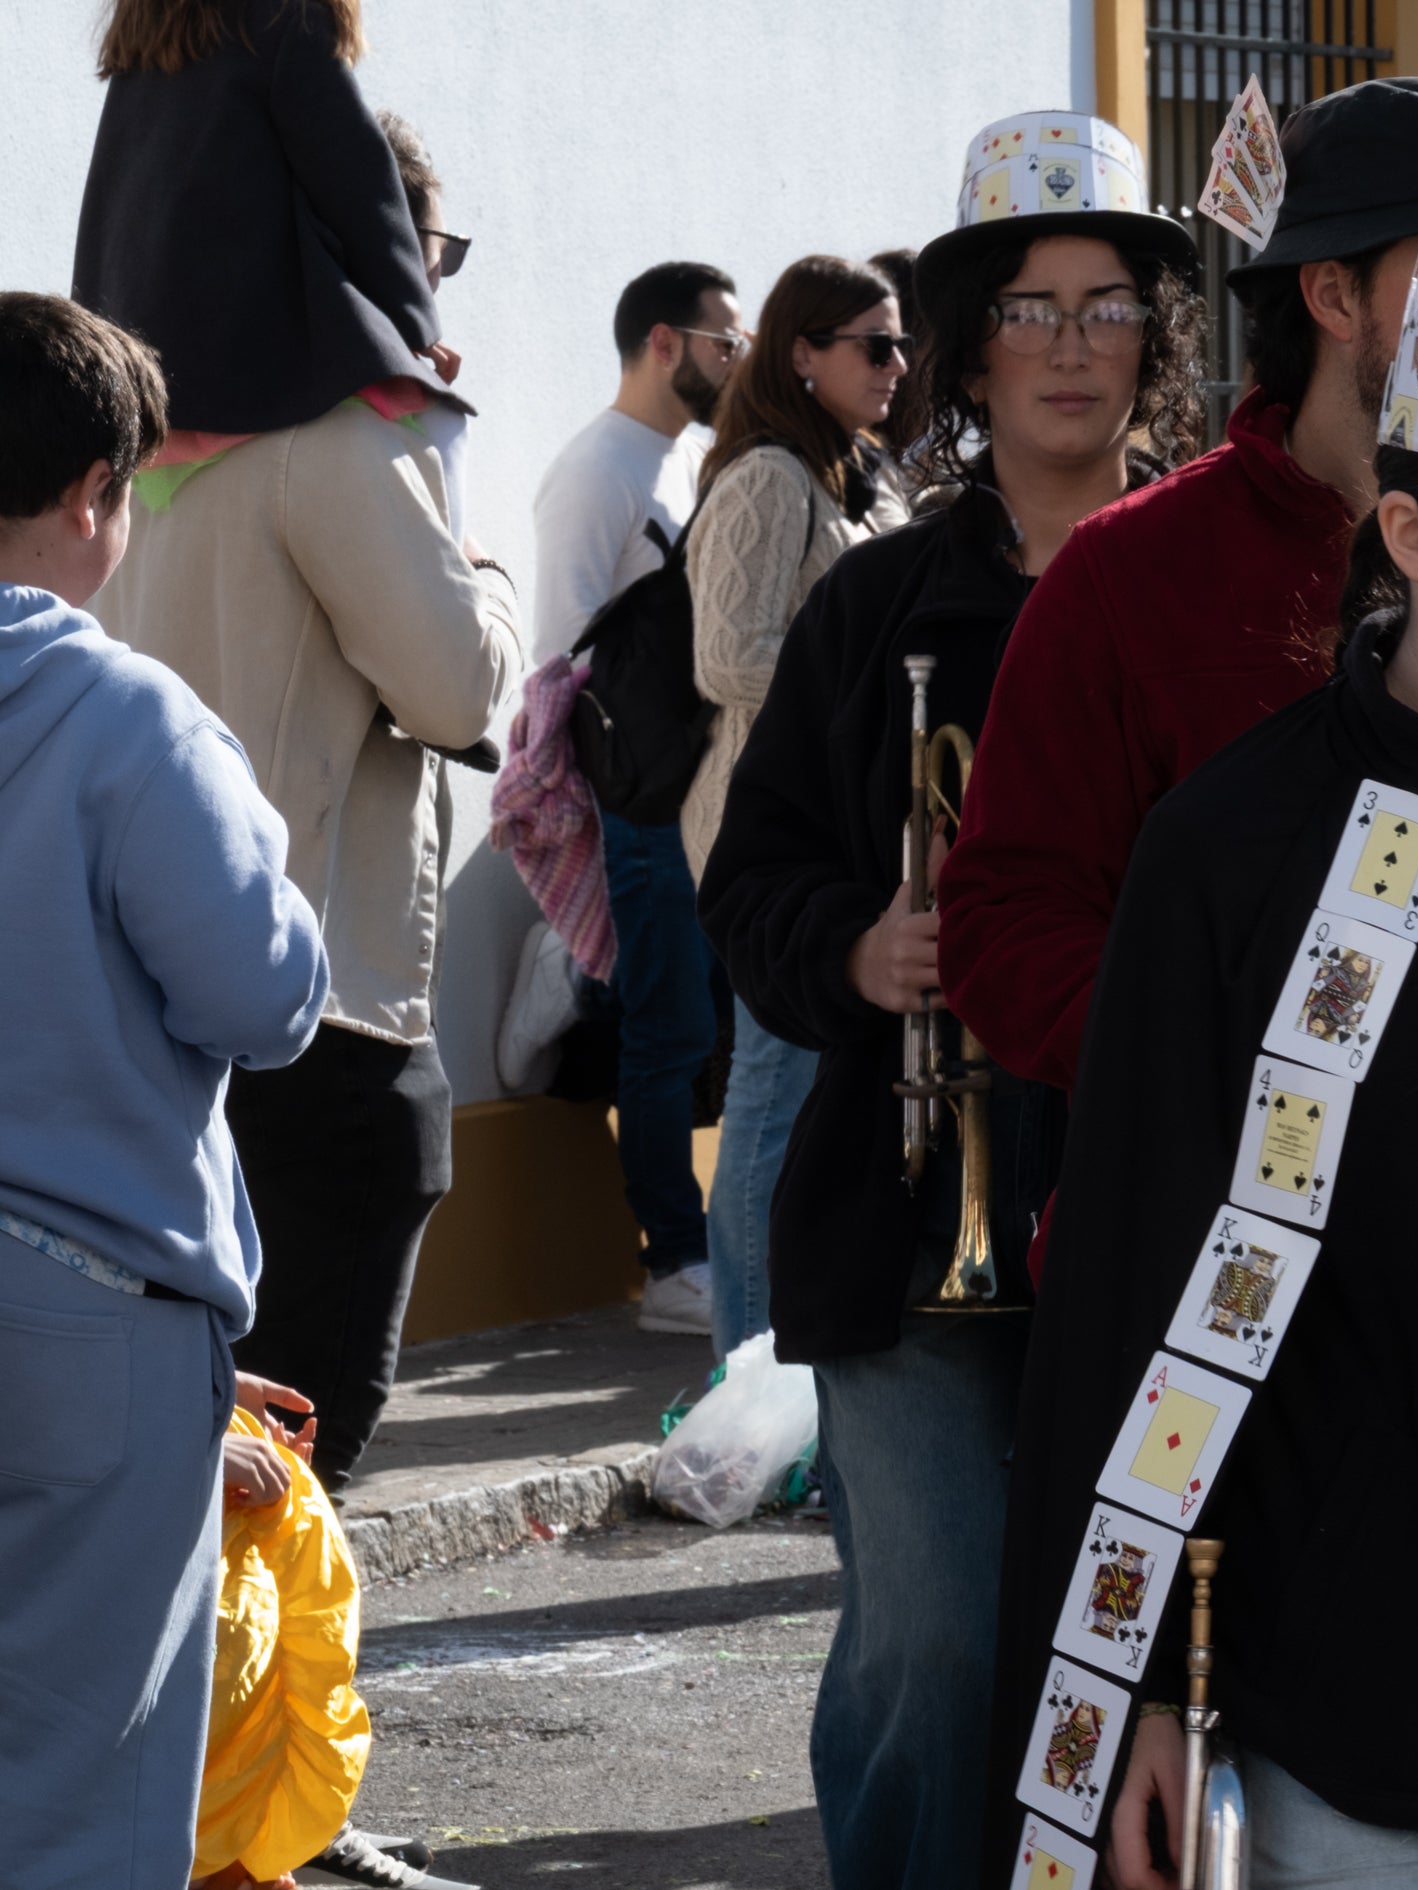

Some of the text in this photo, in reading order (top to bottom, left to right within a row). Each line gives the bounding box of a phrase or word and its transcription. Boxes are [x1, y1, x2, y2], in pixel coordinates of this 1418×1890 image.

[1204, 202, 1212, 213] J
[1363, 791, 1378, 810] 3
[1404, 910, 1418, 931] 3
[1315, 922, 1330, 943] Q
[1349, 1048, 1364, 1069] Q
[1259, 1068, 1272, 1090] 4
[1310, 1195, 1322, 1216] 4
[1217, 1217, 1237, 1240] K
[1248, 1344, 1269, 1368] K
[1151, 1365, 1168, 1388] A
[1180, 1494, 1197, 1517] A
[1094, 1514, 1111, 1538] K
[1125, 1645, 1143, 1669] K
[1053, 1670, 1065, 1691] Q
[1081, 1801, 1093, 1822] Q
[1025, 1825, 1038, 1847] 2
